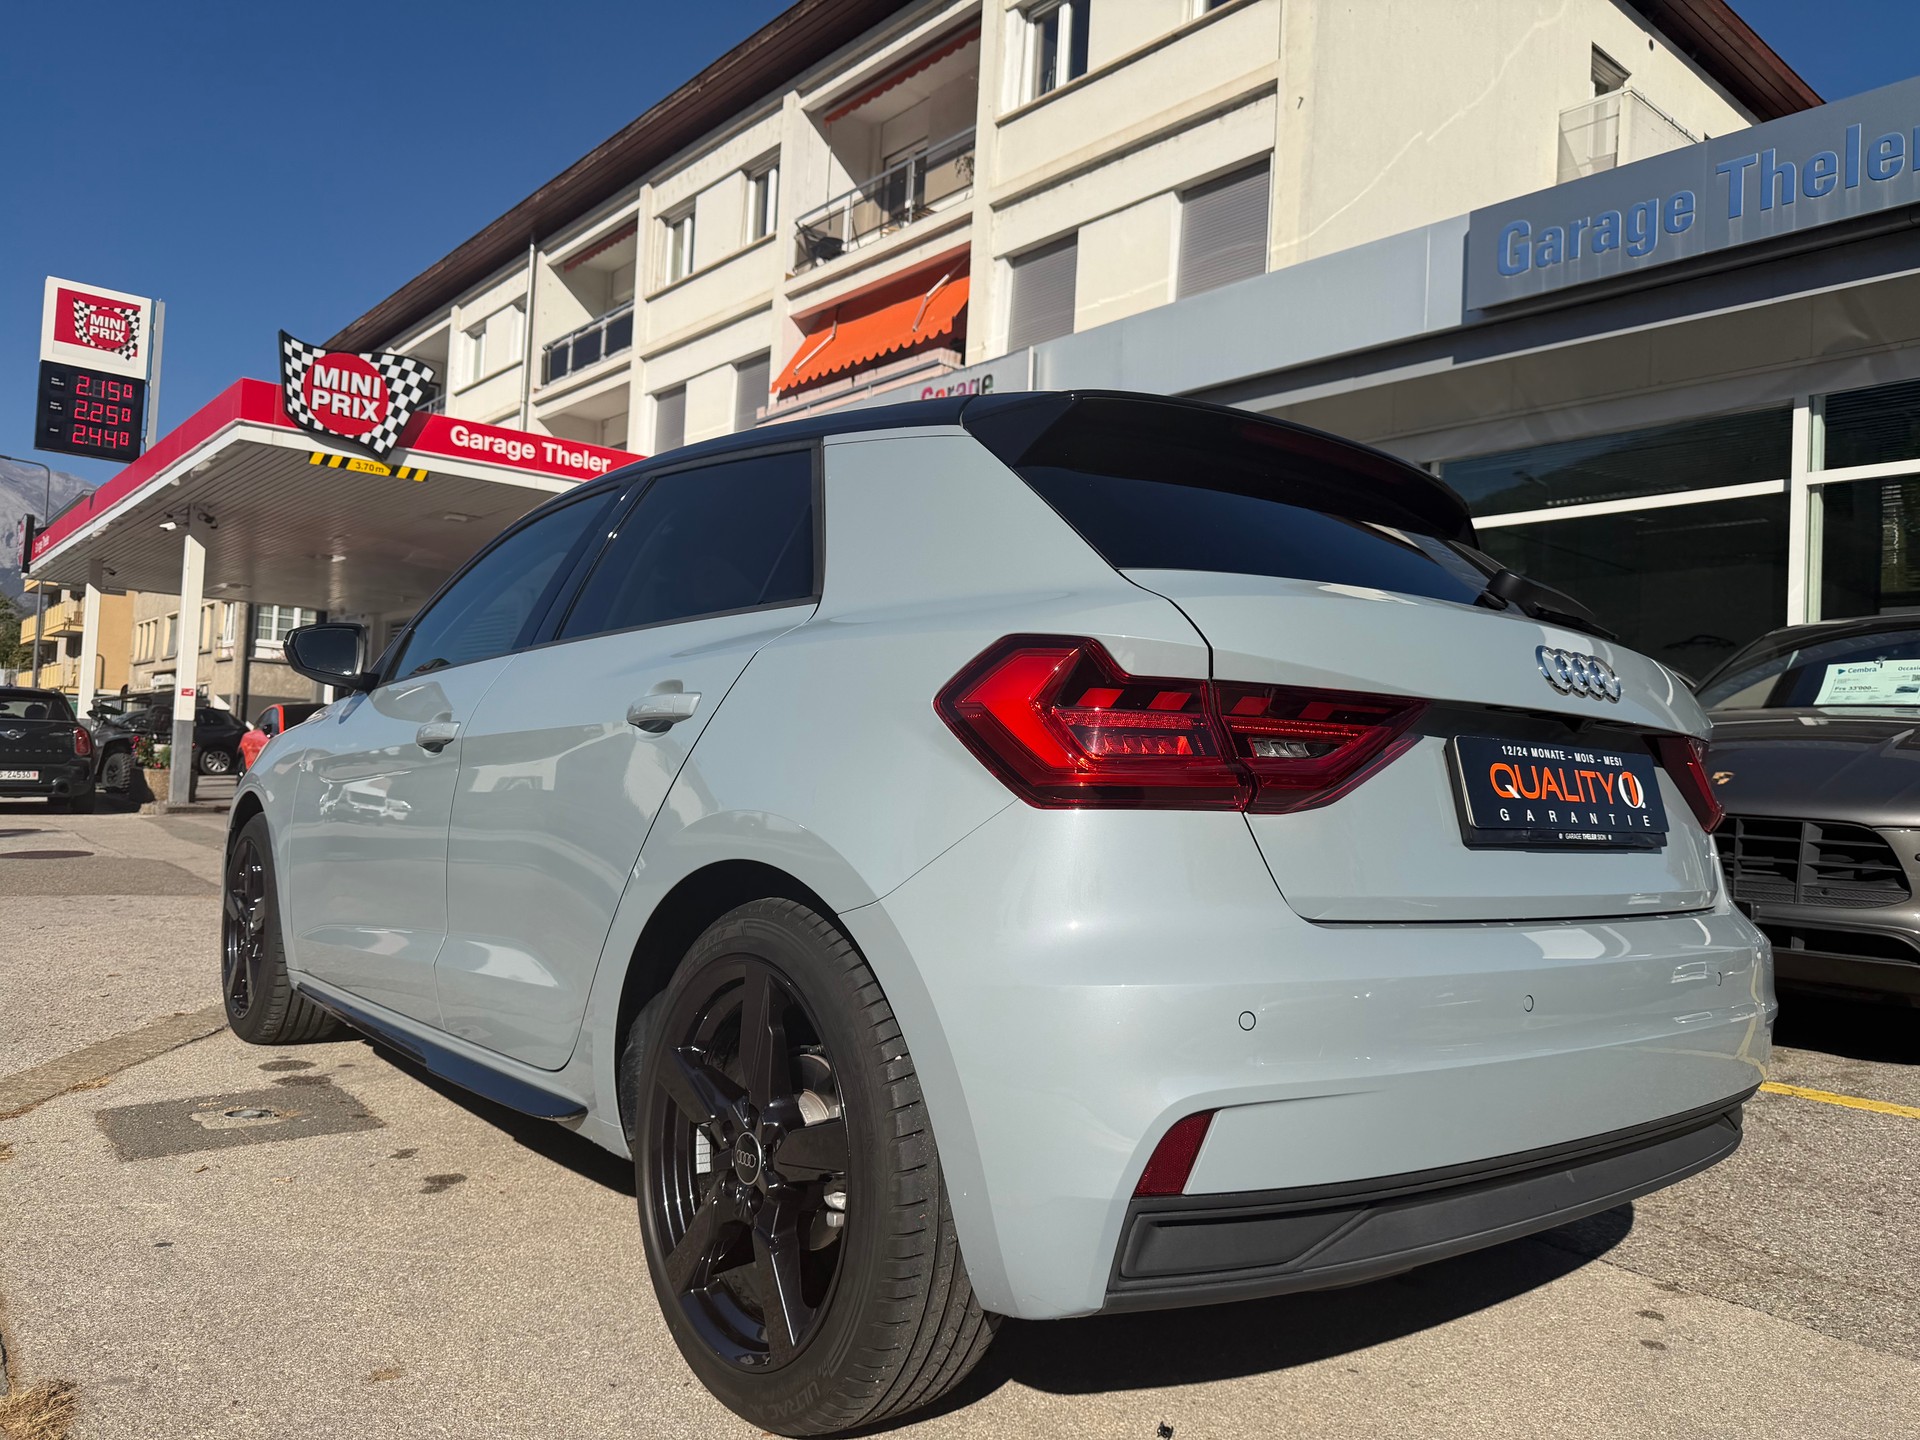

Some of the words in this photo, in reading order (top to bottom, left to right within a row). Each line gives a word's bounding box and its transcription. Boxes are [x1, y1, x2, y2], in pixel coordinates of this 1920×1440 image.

[1497, 189, 1696, 278] Garage
[89, 325, 125, 343] PRIX
[90, 314, 126, 331] MINI
[75, 375, 133, 402] 2.150
[313, 364, 381, 399] MINI
[74, 399, 132, 425] 2.250
[311, 388, 380, 423] PRIX
[72, 423, 129, 449] 2.440
[450, 425, 536, 461] Garage
[541, 442, 611, 474] Theler
[1501, 745, 1528, 757] 12/24
[1531, 747, 1566, 761] MONATE
[1574, 752, 1595, 764] MOIS
[1603, 755, 1623, 767] MESI
[1489, 762, 1614, 805] QUALITY
[1500, 808, 1650, 827] GARANTIE
